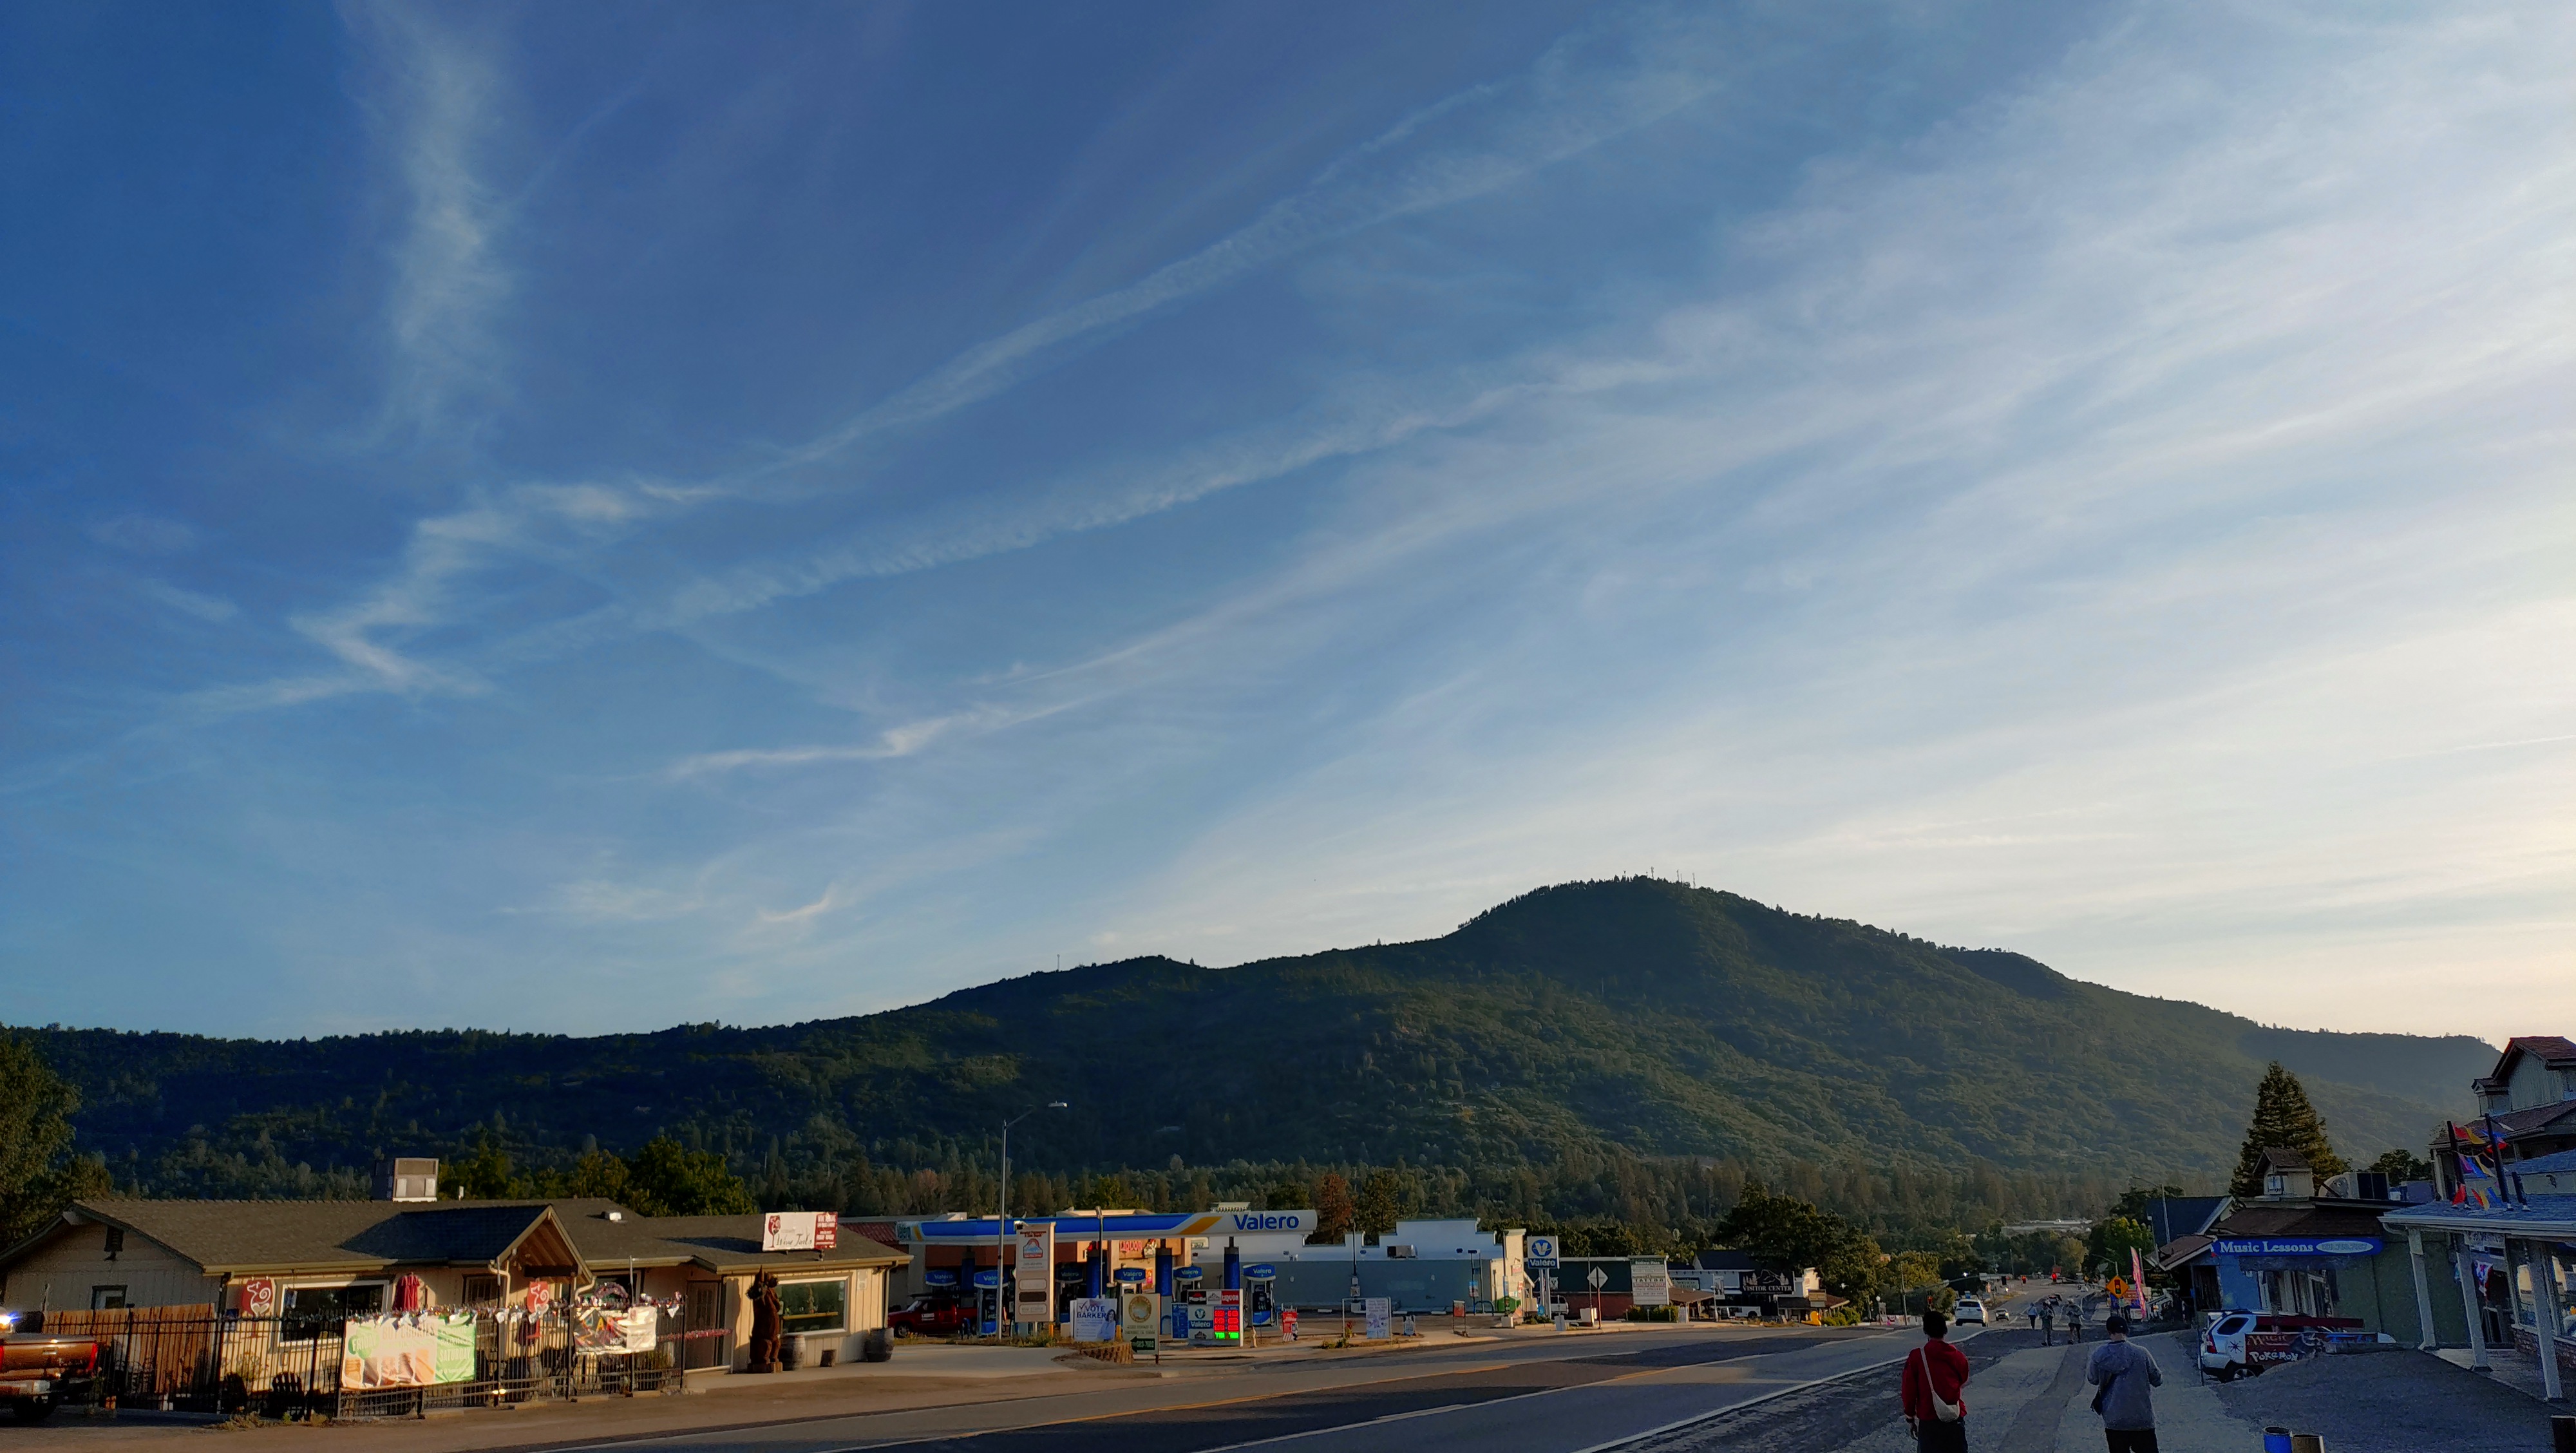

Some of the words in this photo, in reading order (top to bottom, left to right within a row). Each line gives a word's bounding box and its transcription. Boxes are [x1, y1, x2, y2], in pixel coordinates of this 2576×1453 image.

[1233, 1214, 1299, 1230] Valero
[1119, 1240, 1142, 1251] LIQUOR
[2219, 1242, 2260, 1253] Music
[2262, 1241, 2314, 1253] Lessons
[352, 1334, 377, 1352] FRIDAY
[439, 1347, 471, 1362] SATURDAY
